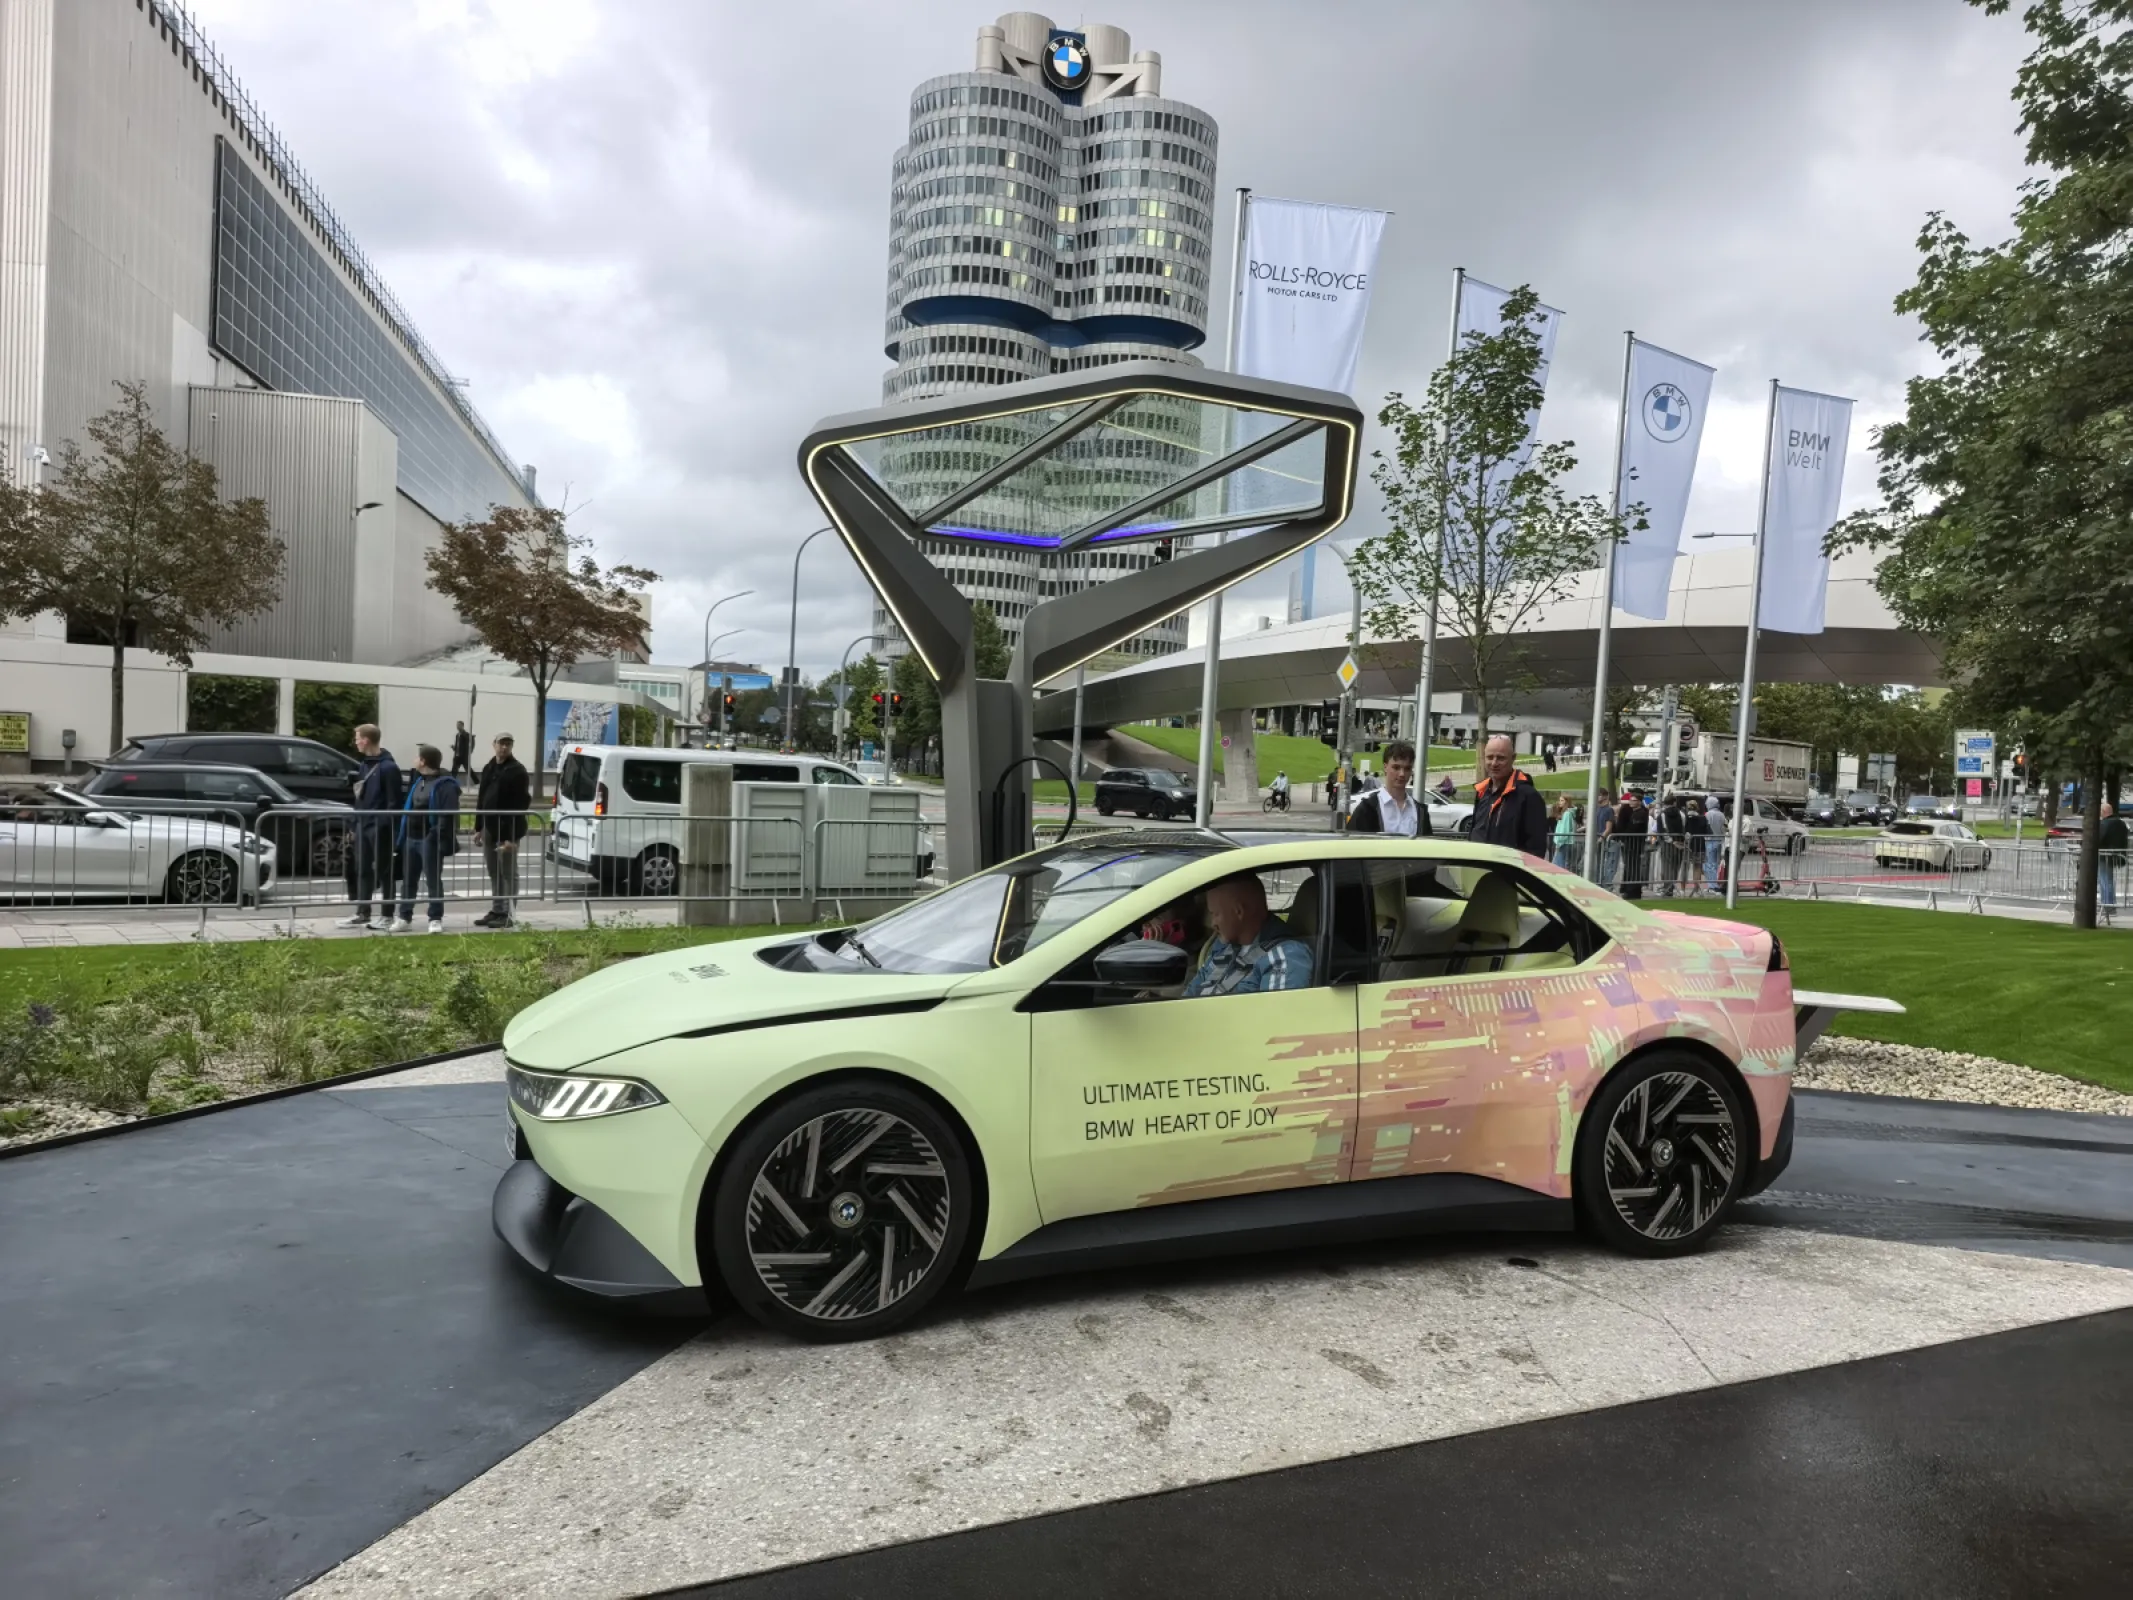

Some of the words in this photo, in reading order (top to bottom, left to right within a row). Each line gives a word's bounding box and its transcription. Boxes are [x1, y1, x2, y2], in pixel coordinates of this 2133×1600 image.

[1049, 37, 1090, 57] BMW
[1249, 260, 1367, 290] ROLLS-ROYCE
[1267, 287, 1298, 297] MOTOR
[1299, 290, 1320, 299] CARS
[1322, 294, 1338, 302] LTD
[1652, 386, 1688, 407] BMW
[1788, 429, 1831, 453] BMW
[1787, 447, 1822, 470] Welt
[1776, 766, 1805, 780] SCHENKER
[1083, 1079, 1180, 1105] ULTIMATE
[1183, 1073, 1271, 1097] TESTING.
[1085, 1118, 1134, 1141] BMW
[1145, 1112, 1211, 1136] HEART
[1215, 1109, 1241, 1130] OF
[1245, 1107, 1279, 1129] JOY
